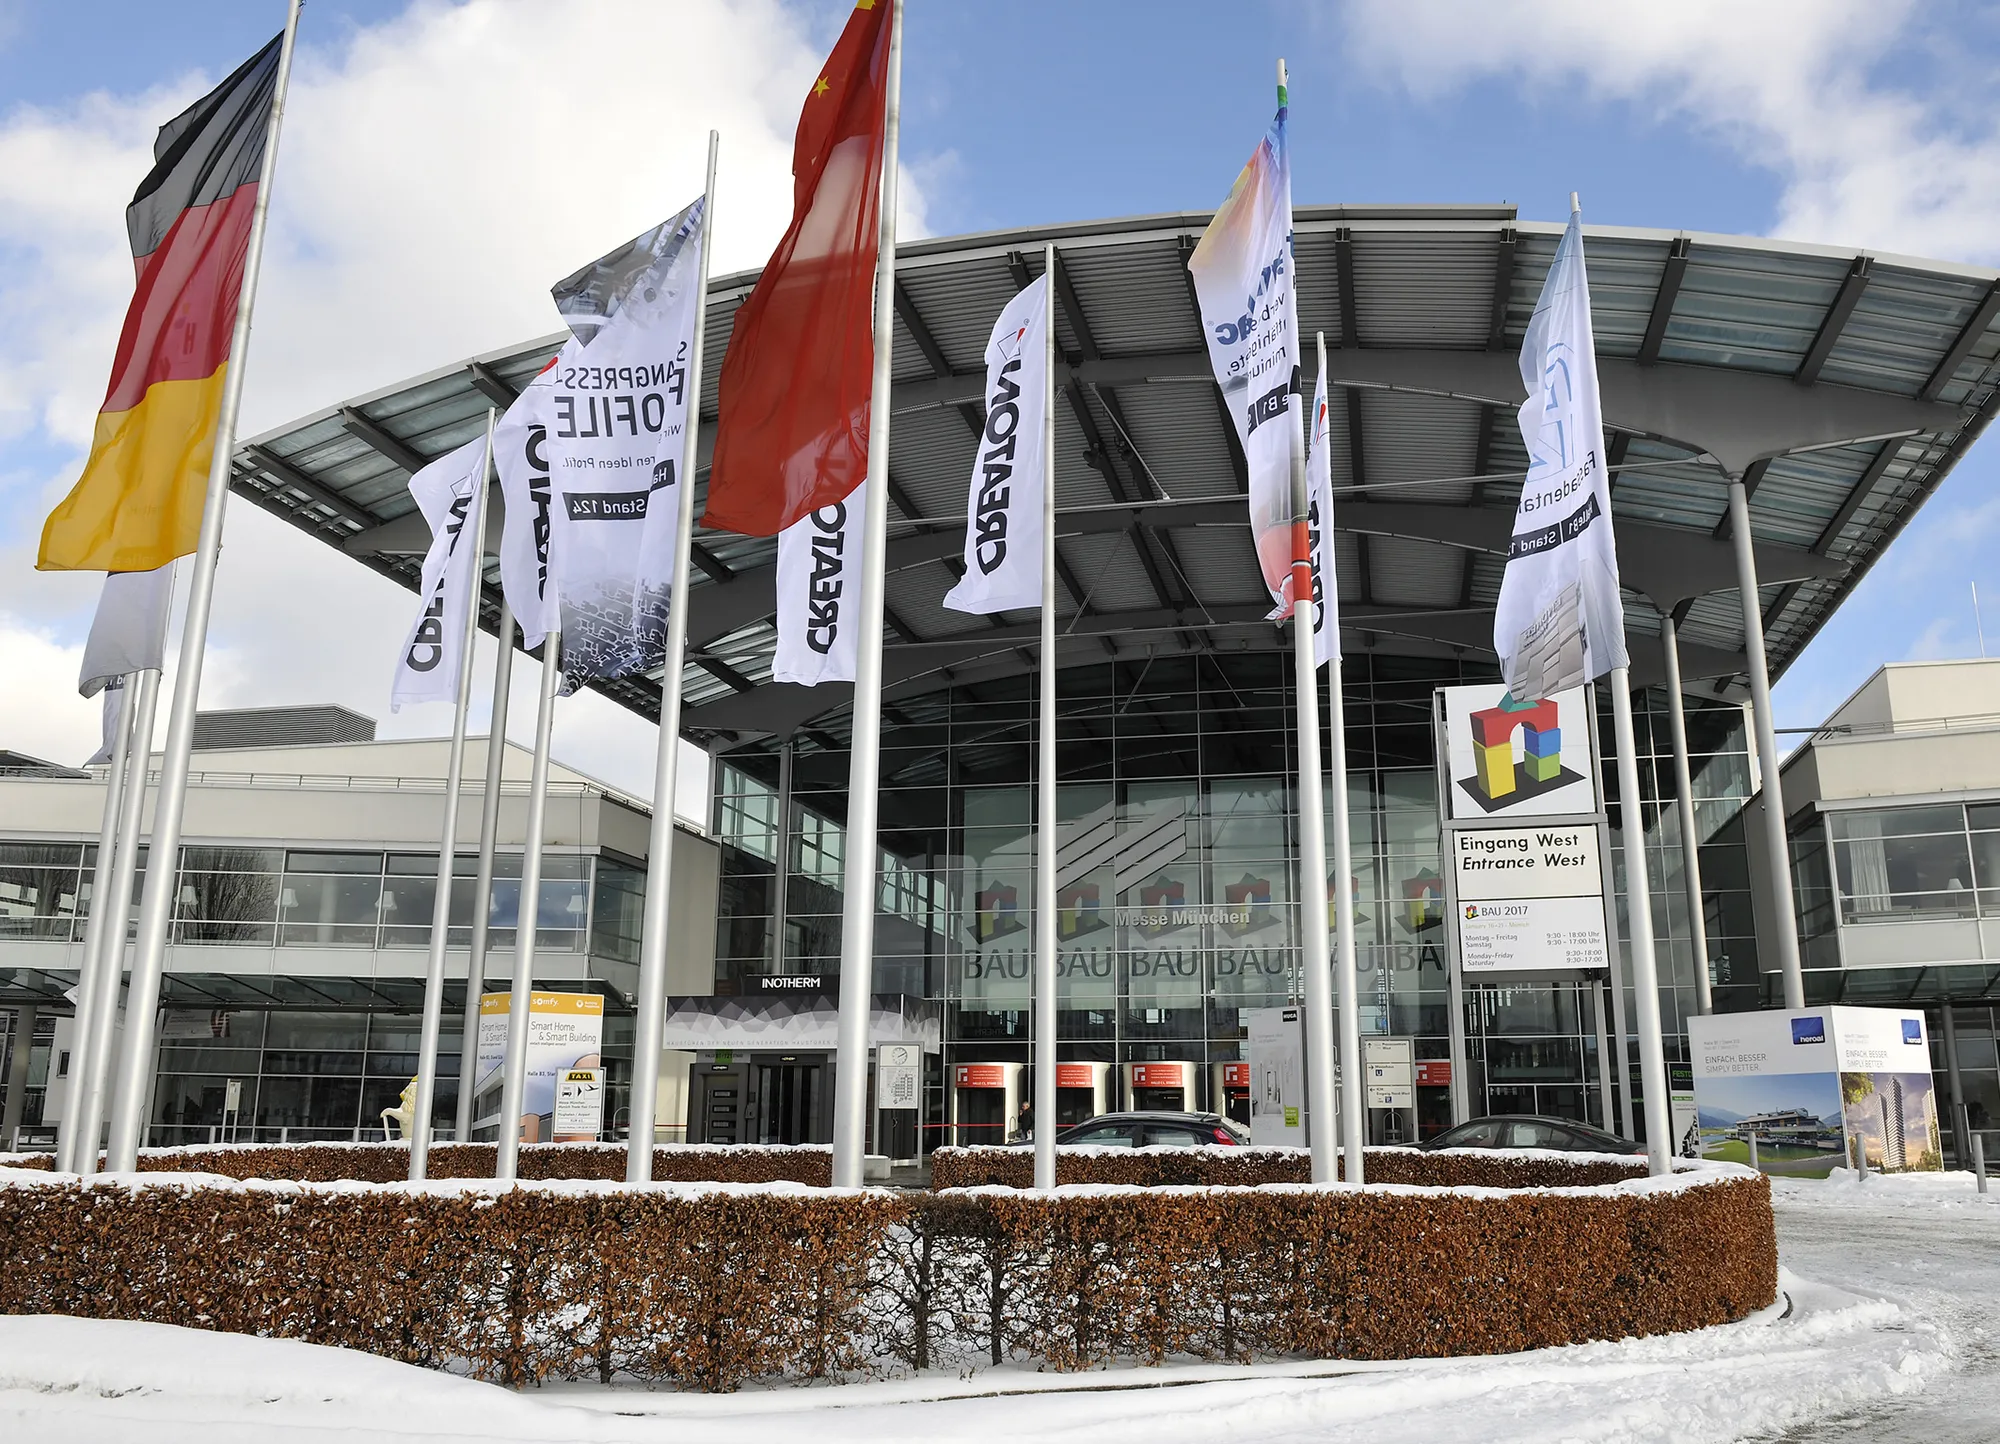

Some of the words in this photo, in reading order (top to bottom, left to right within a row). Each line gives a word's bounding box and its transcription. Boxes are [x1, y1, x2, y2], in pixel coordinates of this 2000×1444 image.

[1460, 836, 1529, 853] Eingang
[1536, 833, 1579, 847] West
[1462, 856, 1535, 871] Entrance
[1544, 852, 1586, 867] West
[1481, 907, 1502, 917] BAU
[1504, 906, 1528, 916] 2017
[1115, 912, 1168, 928] Messe
[1172, 909, 1250, 926] München
[1465, 935, 1490, 943] Montag
[1496, 933, 1518, 942] Freitag
[1588, 930, 1600, 938] Uhr
[1465, 941, 1492, 949] Samstag
[1589, 937, 1600, 945] Uhr
[963, 948, 1029, 980] BAU
[1131, 945, 1198, 977] BAU
[1216, 943, 1285, 976] BAU
[1467, 959, 1495, 967] Saturday
[761, 977, 821, 989] INOTHERM
[531, 1021, 553, 1031] Smart
[554, 1022, 576, 1032] Home
[538, 1031, 544, 1041] &
[545, 1032, 568, 1042] Smart
[569, 1033, 597, 1045] Building
[1800, 1034, 1824, 1044] heroal
[1705, 1065, 1731, 1074] SIMPLY
